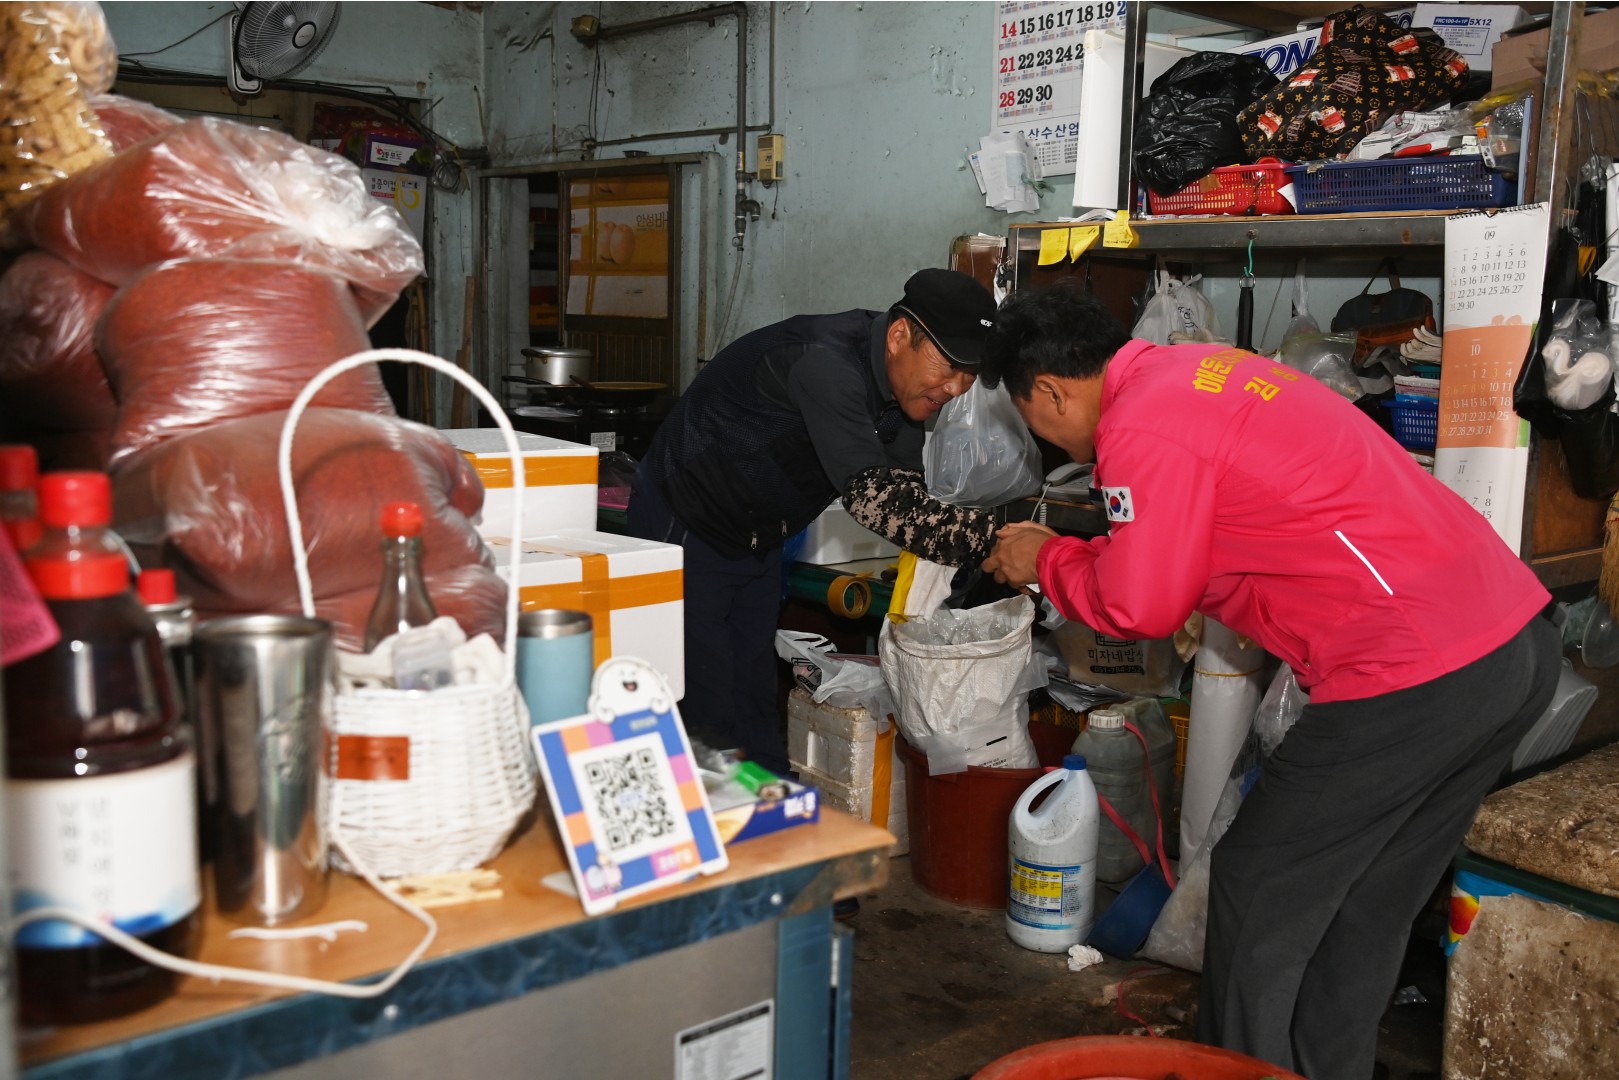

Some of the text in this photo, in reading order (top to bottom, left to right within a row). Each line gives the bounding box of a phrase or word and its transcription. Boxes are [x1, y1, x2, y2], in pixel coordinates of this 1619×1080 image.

[1001, 21, 1017, 39] 14
[1020, 17, 1035, 35] 15
[1038, 13, 1054, 31] 16
[1057, 9, 1074, 27] 17
[1076, 5, 1094, 24] 18
[1096, 1, 1115, 20] 19
[1117, 1, 1126, 16] 2
[1469, 18, 1492, 26] 5X12
[1000, 43, 1084, 73] 21 22 23 24 2
[1000, 84, 1053, 108] 28 29 30
[1484, 230, 1496, 240] 09
[1473, 252, 1478, 260] 2
[1484, 251, 1490, 259] 3
[1496, 250, 1501, 258] 4
[1508, 248, 1514, 257] 5
[1520, 248, 1526, 256] 6
[1461, 265, 1466, 274] 8
[1472, 265, 1477, 273] 9
[1481, 263, 1490, 271] 10
[1492, 262, 1501, 270] 11
[1504, 261, 1514, 270] 12
[1517, 260, 1526, 269] 13
[1459, 278, 1467, 286] 15
[1469, 276, 1477, 285] 16
[1480, 275, 1488, 284] 17
[1491, 274, 1500, 283] 18
[1503, 273, 1512, 282] 19
[1514, 272, 1525, 281] 20
[1457, 290, 1465, 299] 22
[1467, 289, 1475, 298] 23
[1477, 288, 1486, 296] 24
[1488, 286, 1498, 295] 25
[1500, 286, 1510, 294] 26
[1512, 284, 1523, 293] 27
[1457, 302, 1465, 311] 29
[1465, 301, 1475, 310] 30
[1471, 344, 1480, 356] 10
[1481, 368, 1487, 378] 2
[1505, 368, 1512, 378] 4
[1489, 382, 1499, 392] 10
[1502, 382, 1512, 392] 11
[1453, 400, 1459, 409] 13
[1461, 399, 1469, 407] 14
[1470, 398, 1478, 407] 15
[1480, 398, 1487, 407] 16
[1489, 396, 1497, 406] 17
[1500, 397, 1511, 406] 18
[1451, 414, 1459, 422] 20
[1460, 413, 1467, 421] 21
[1469, 412, 1477, 421] 22
[1478, 411, 1486, 421] 23
[1487, 411, 1496, 420] 24
[1497, 411, 1509, 420] 25
[1448, 427, 1457, 436] 27
[1457, 426, 1466, 436] 28
[1466, 426, 1475, 436] 29
[1476, 425, 1484, 435] 30
[1484, 425, 1492, 435] 31
[1458, 464, 1465, 474] 11
[1473, 497, 1491, 507] 7 8
[1482, 511, 1492, 519] 15
